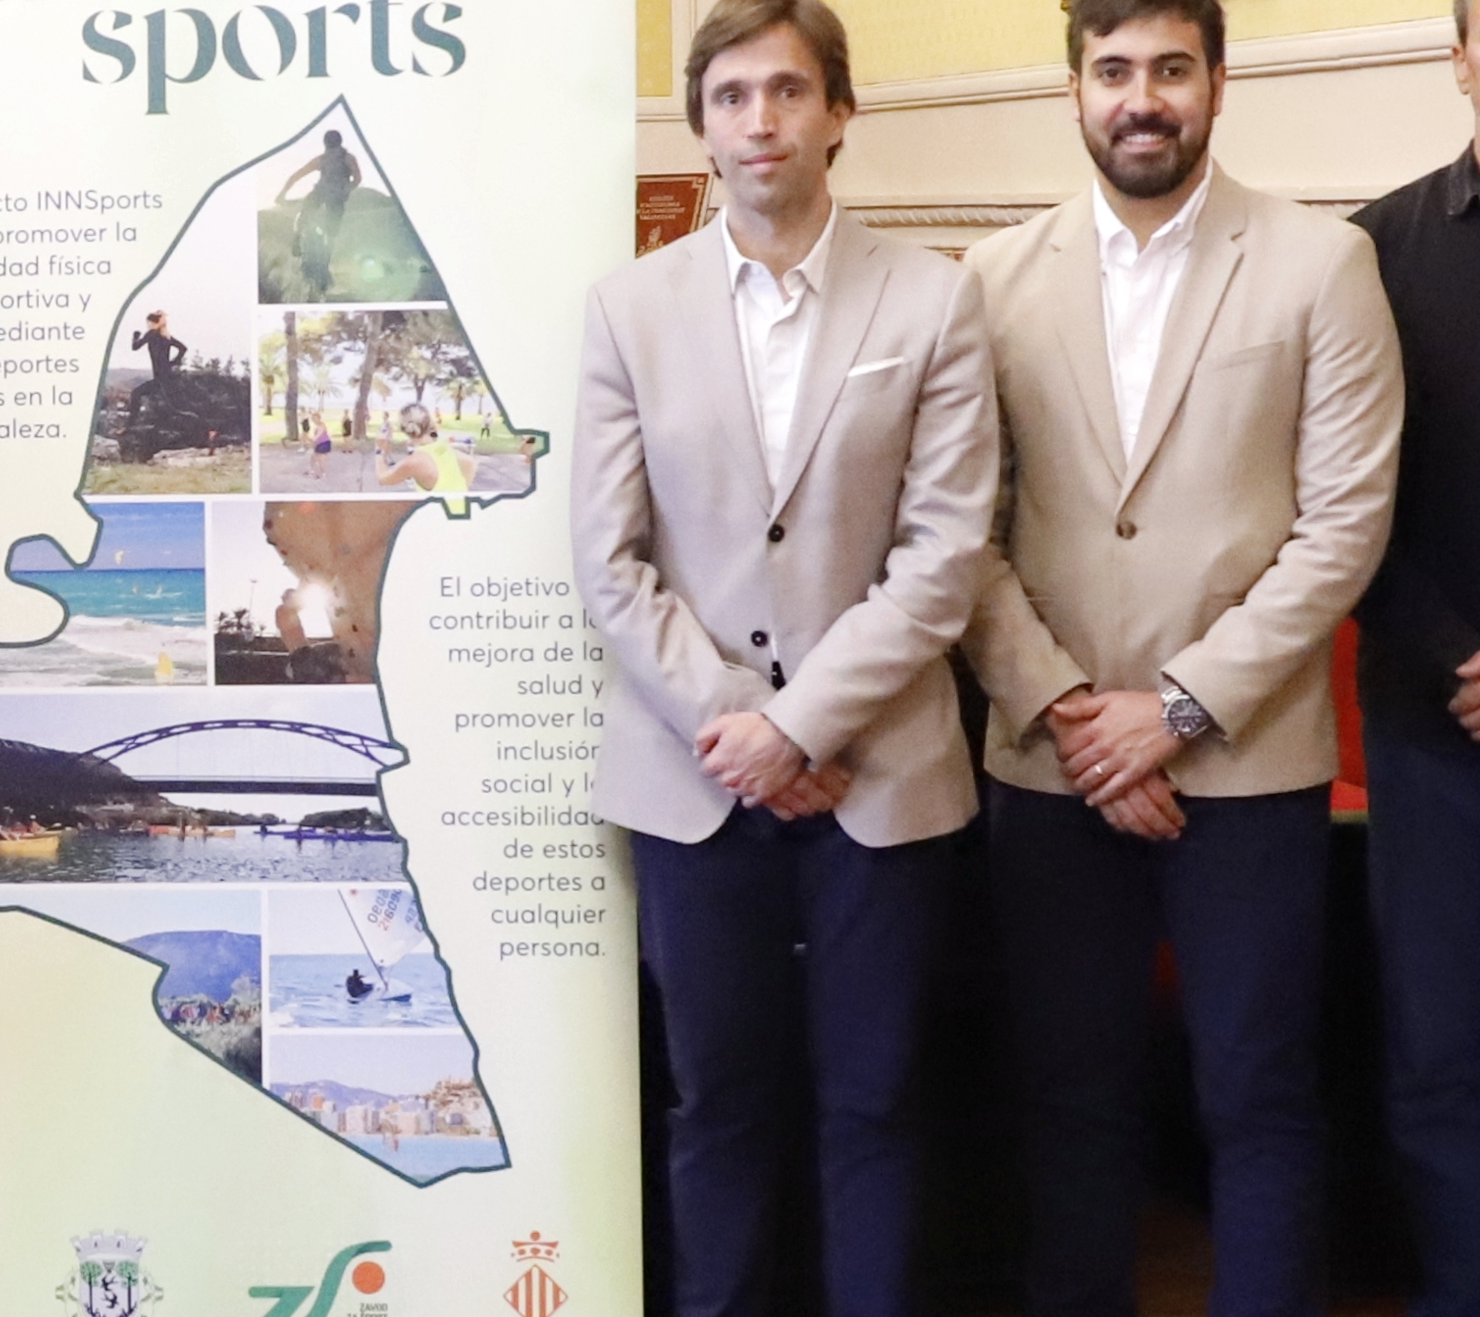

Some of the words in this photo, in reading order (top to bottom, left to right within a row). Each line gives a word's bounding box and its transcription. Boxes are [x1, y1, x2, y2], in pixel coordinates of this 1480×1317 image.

[37, 190, 163, 215] INNSports
[116, 221, 138, 243] la
[48, 254, 113, 277] física
[79, 292, 92, 313] y
[13, 390, 43, 407] en
[52, 385, 74, 406] la
[440, 576, 461, 598] El
[469, 576, 571, 603] objetivo
[428, 608, 550, 630] contribuir
[558, 614, 574, 630] a
[448, 642, 535, 669] mejora
[543, 640, 574, 663] de
[583, 640, 604, 662] la
[517, 673, 583, 696] salud
[591, 679, 604, 700] y
[454, 711, 576, 734] promover
[583, 706, 605, 728] la
[480, 771, 553, 794] social
[561, 778, 575, 798] y
[583, 771, 595, 793] l
[502, 836, 534, 860] de
[542, 838, 607, 860] estos
[471, 870, 583, 897] deportes
[590, 875, 607, 892] a
[490, 902, 607, 930] cualquier
[499, 940, 607, 962] persona.
